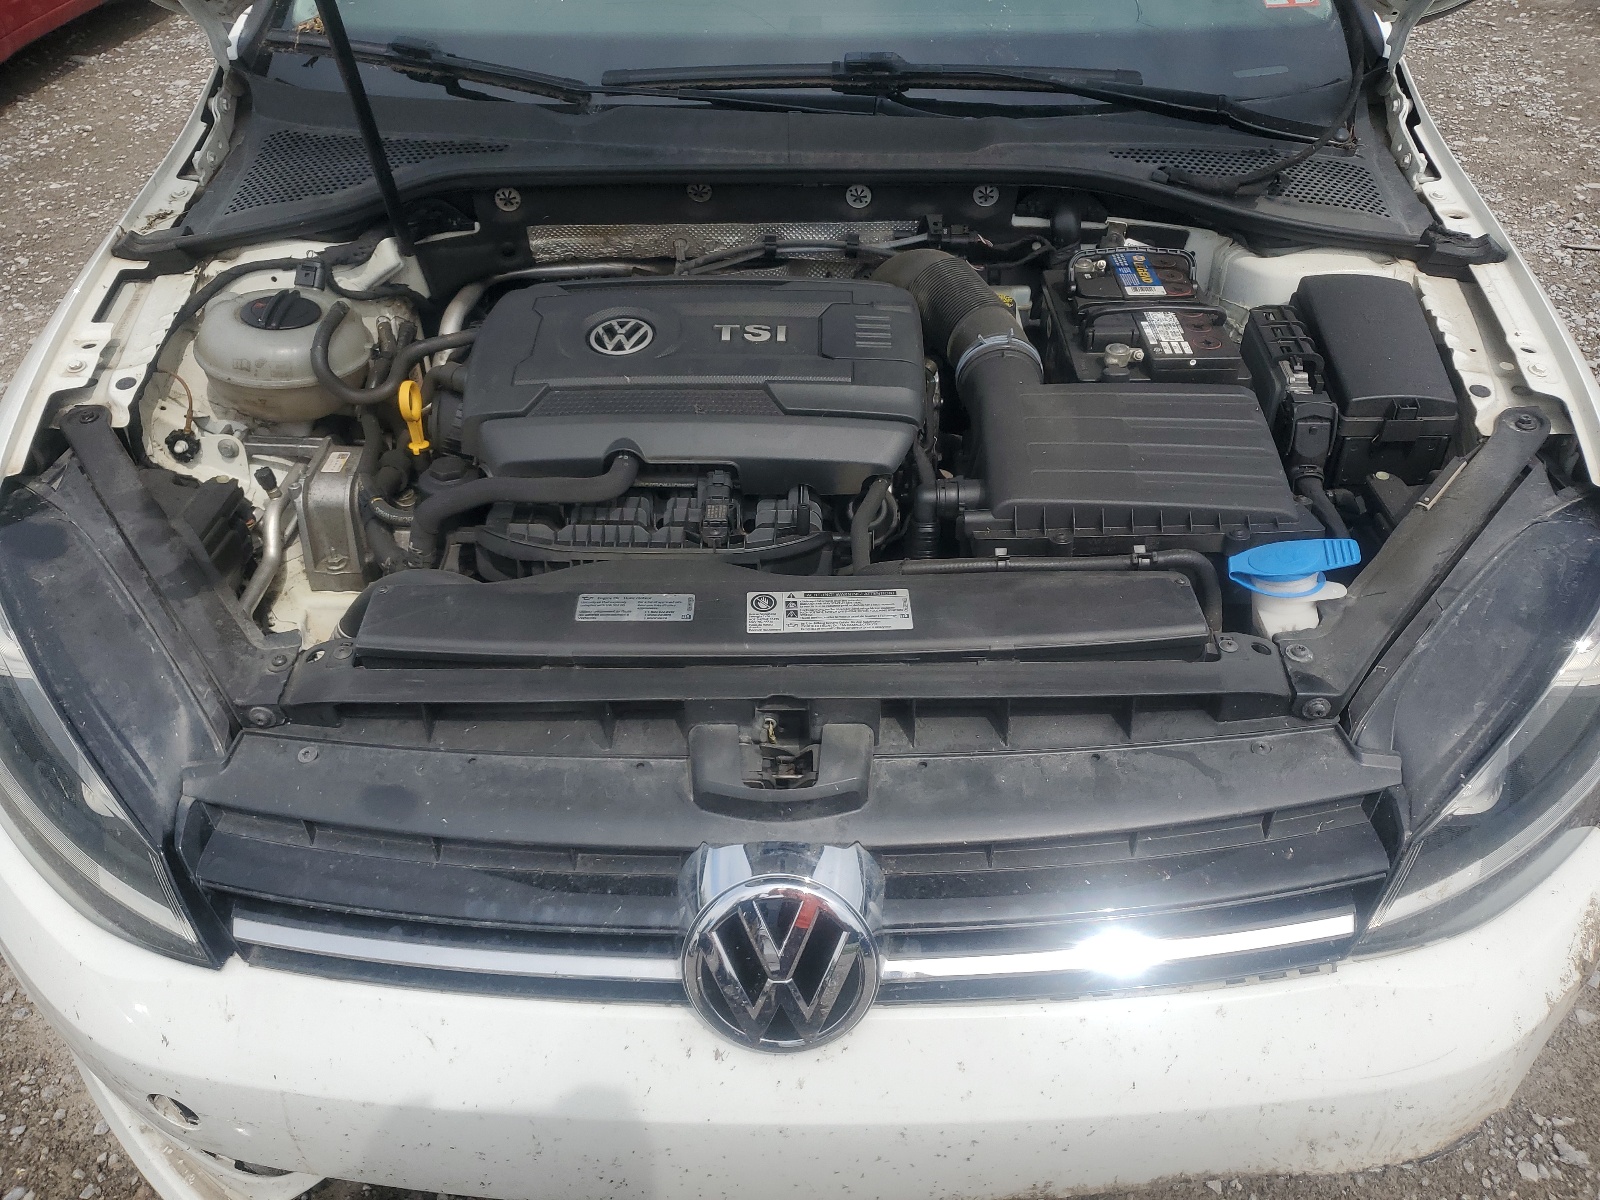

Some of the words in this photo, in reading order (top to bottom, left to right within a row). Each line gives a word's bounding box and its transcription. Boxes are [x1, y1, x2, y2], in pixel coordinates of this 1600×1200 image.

[591, 318, 653, 354] VW
[713, 324, 787, 342] TSI
[692, 894, 865, 1047] VW
